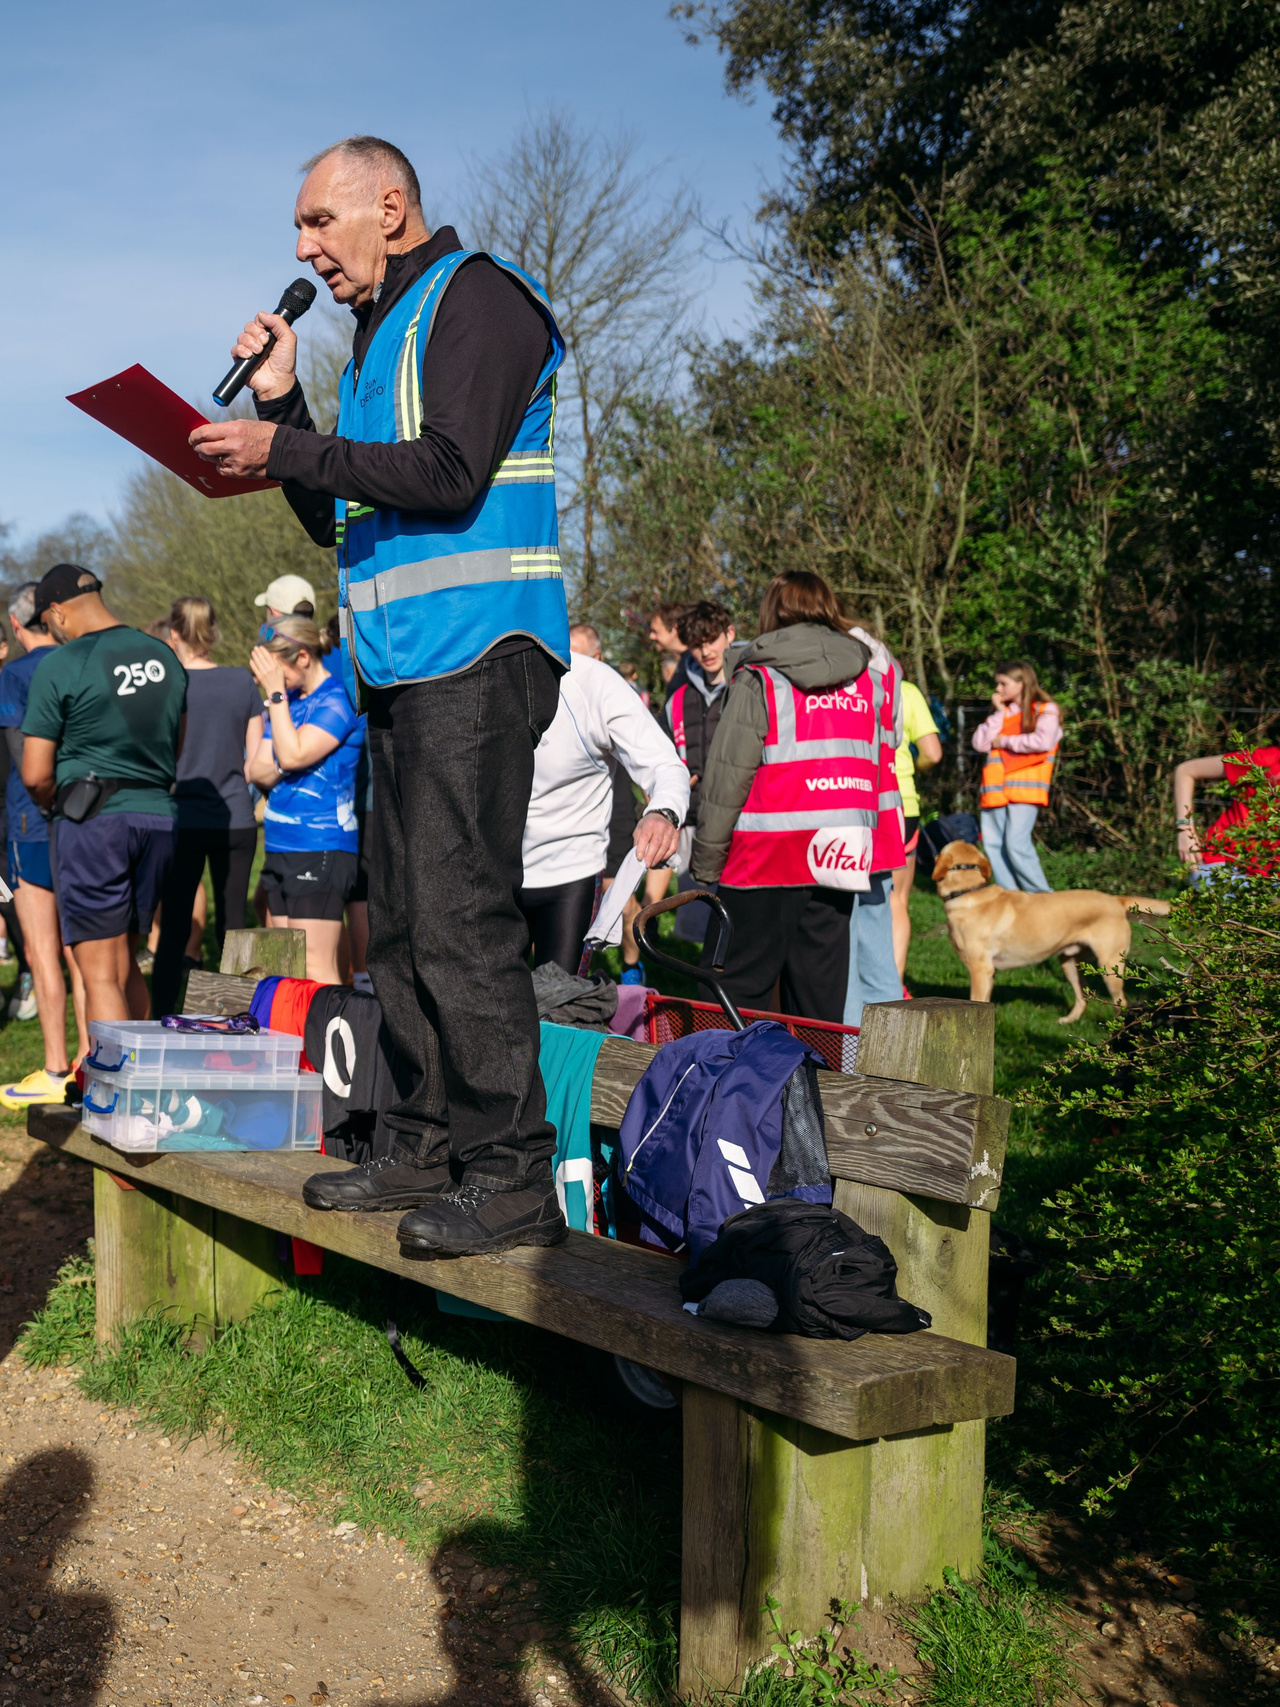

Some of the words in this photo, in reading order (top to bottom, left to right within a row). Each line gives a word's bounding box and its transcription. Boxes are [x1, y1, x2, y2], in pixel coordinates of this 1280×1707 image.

[360, 384, 386, 408] DECTO
[113, 659, 166, 696] 250
[805, 688, 869, 714] parkrun
[812, 837, 871, 876] Vital
